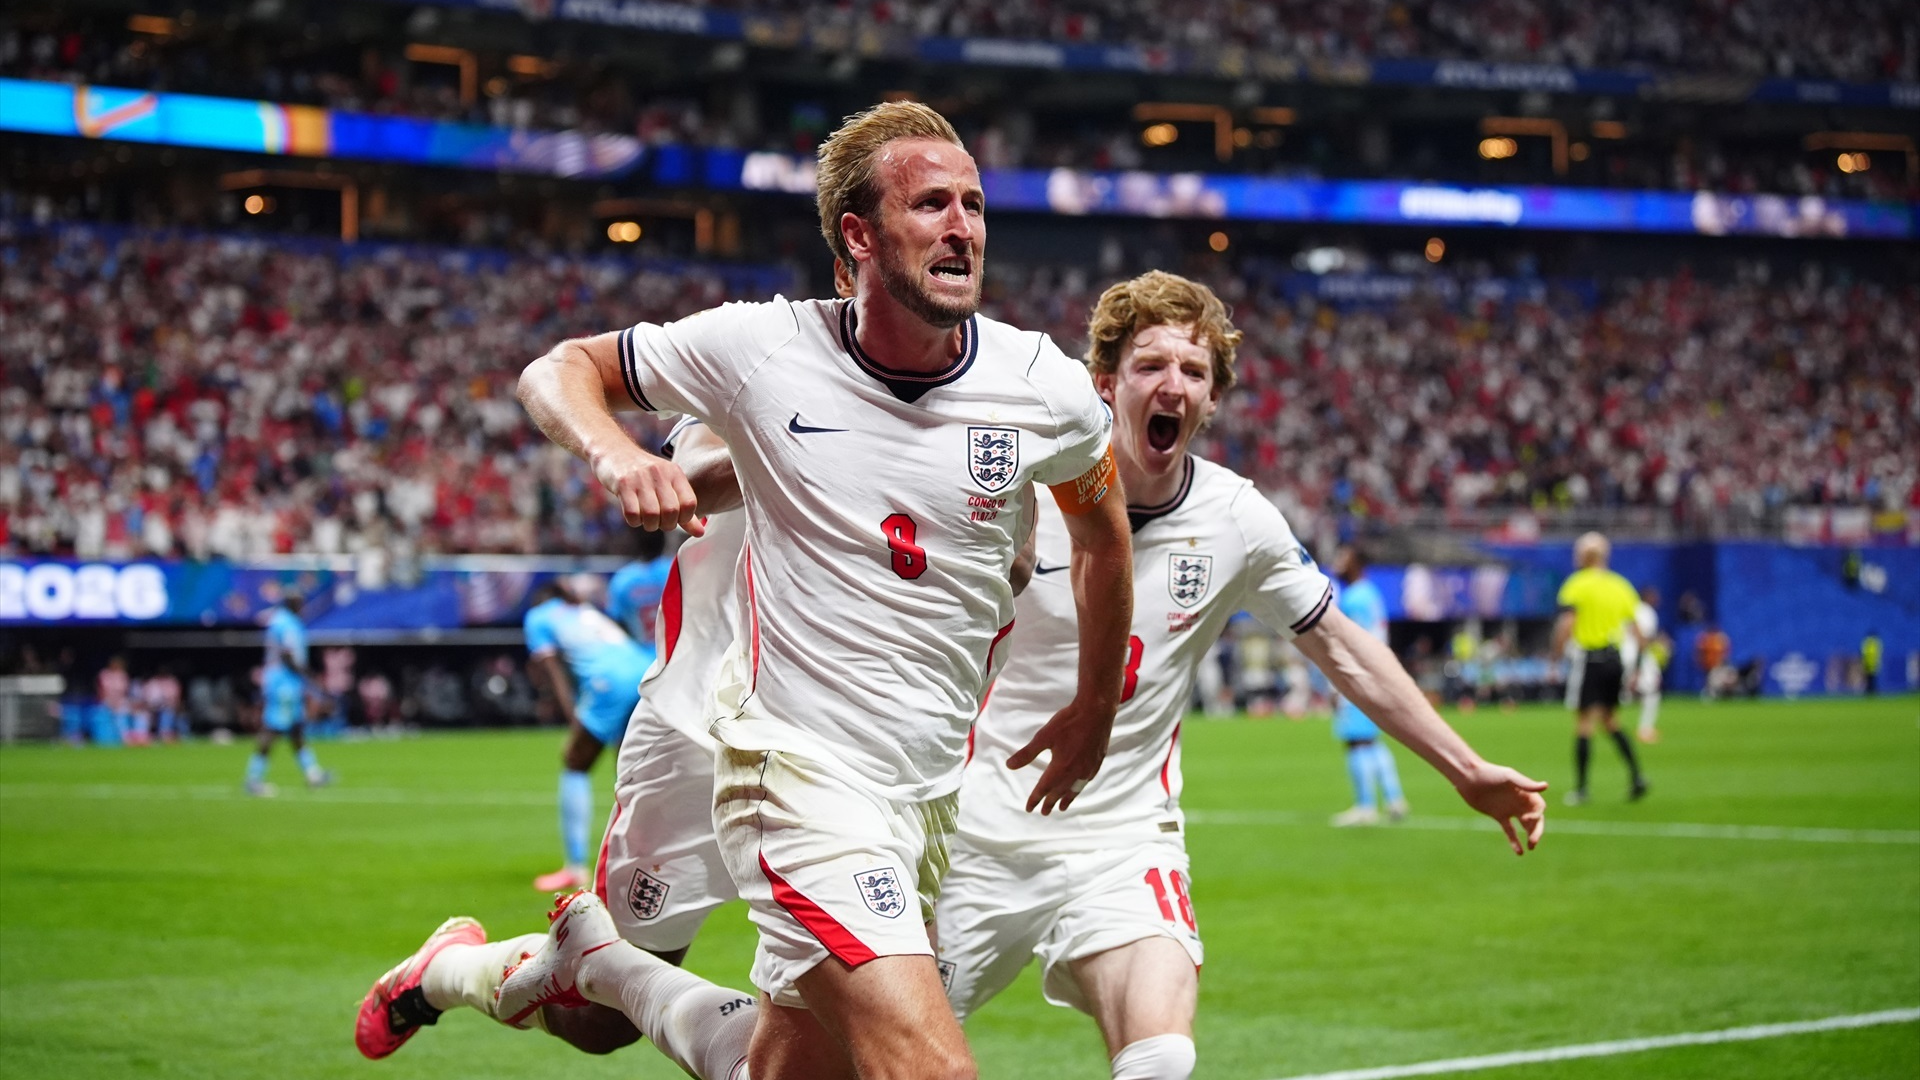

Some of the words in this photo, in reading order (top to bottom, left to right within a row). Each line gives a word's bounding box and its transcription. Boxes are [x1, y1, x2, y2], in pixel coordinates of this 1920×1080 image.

[1077, 454, 1111, 495] UNITES
[968, 496, 996, 508] CONGO
[0, 563, 167, 620] 2026
[1144, 867, 1196, 933] 18
